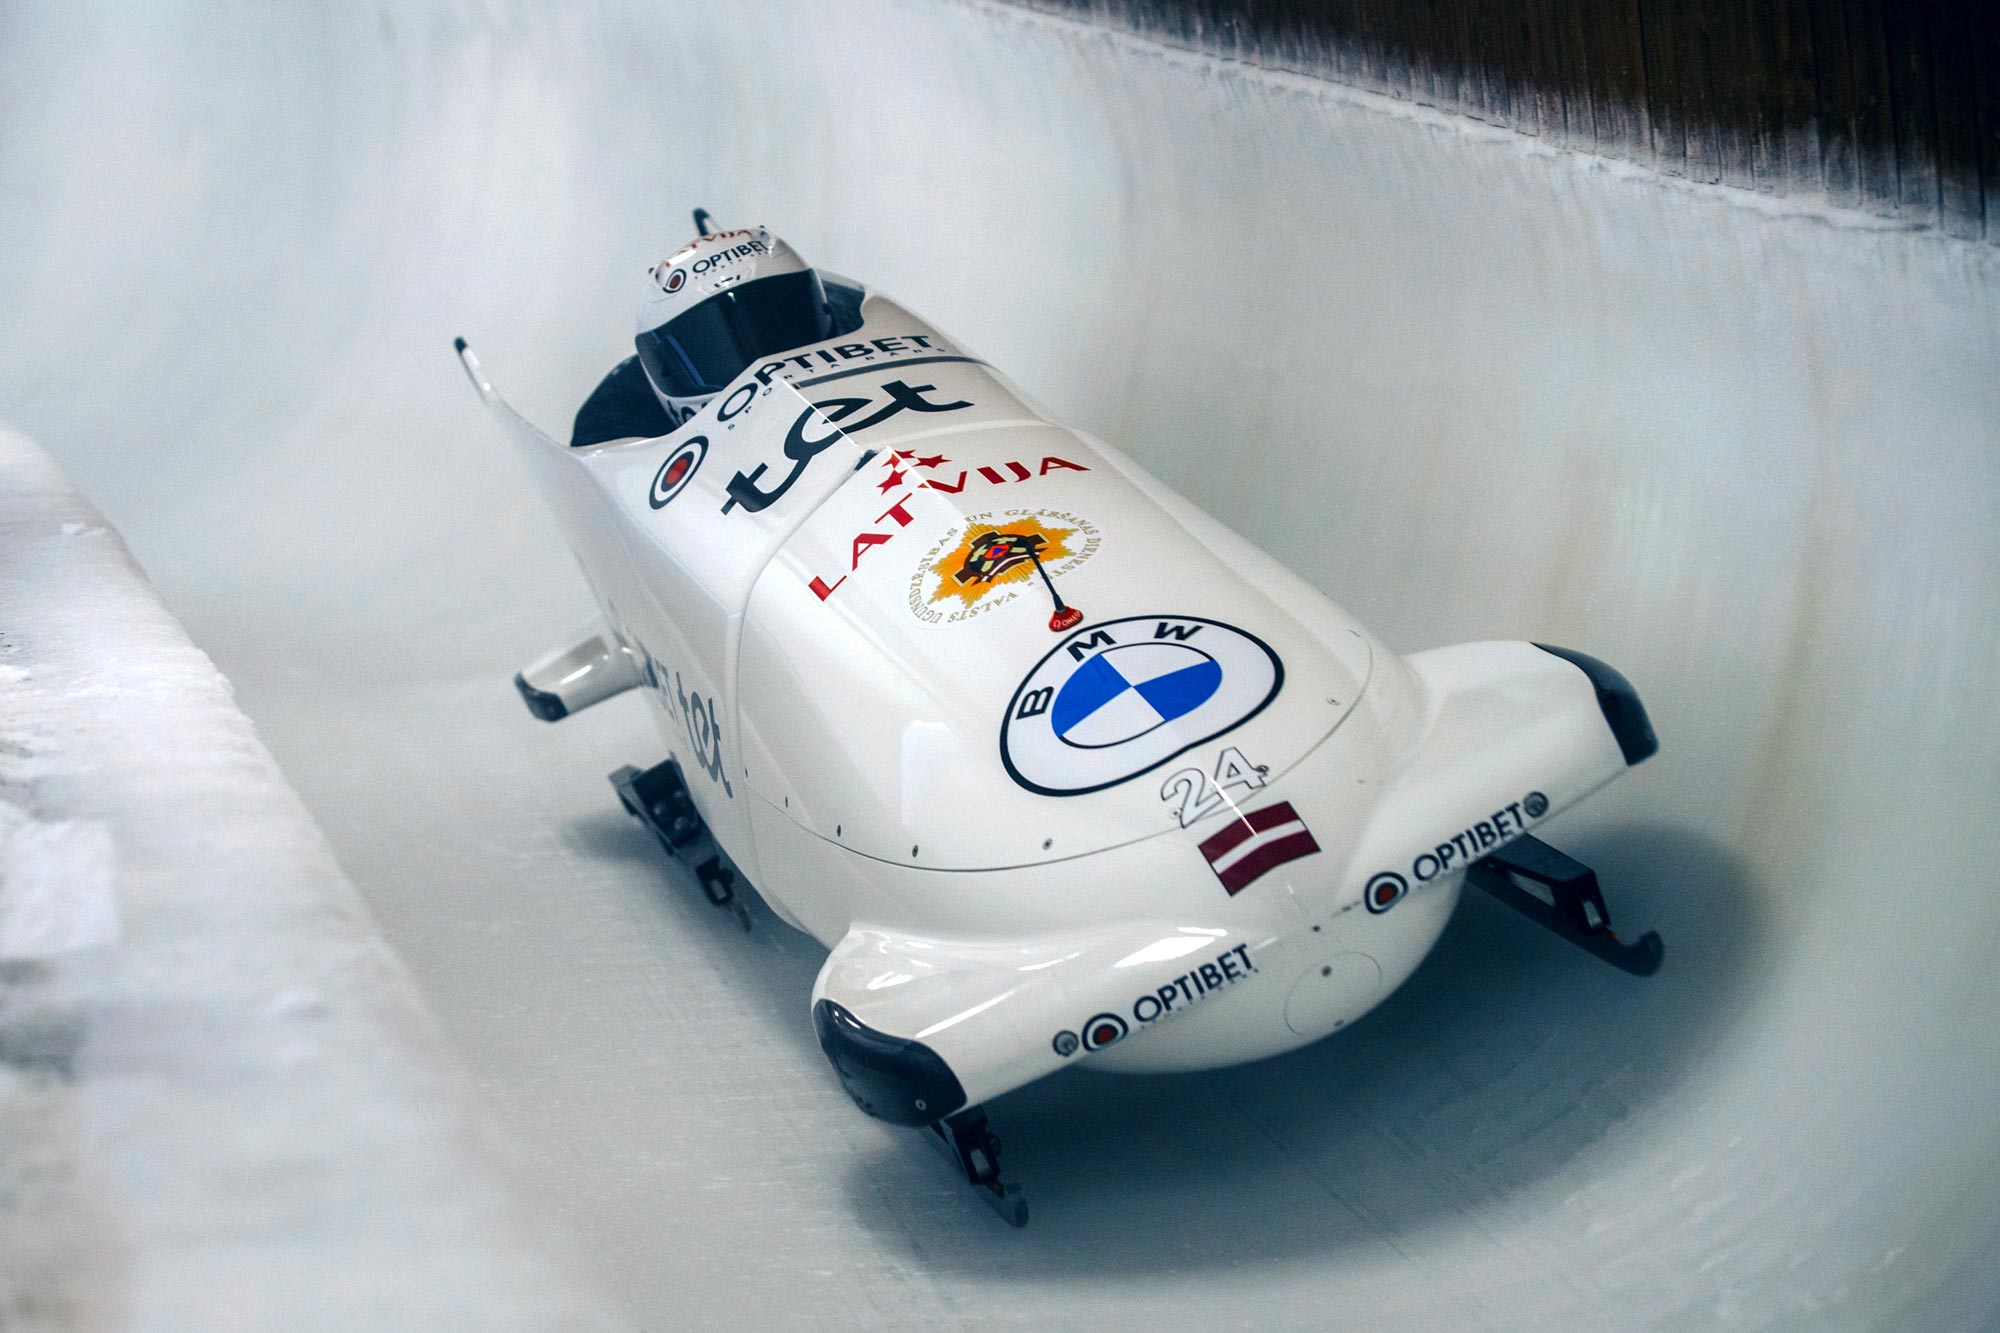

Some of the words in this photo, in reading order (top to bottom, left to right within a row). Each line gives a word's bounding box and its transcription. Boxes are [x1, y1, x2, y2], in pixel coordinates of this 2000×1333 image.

[692, 241, 769, 274] OPTIBET
[717, 335, 932, 422] OPTIBET
[808, 456, 1092, 602] LATVIJA
[1016, 621, 1204, 721] BMW
[1160, 746, 1269, 829] 24
[1413, 802, 1525, 881] OPTIBET
[1133, 943, 1253, 1023] OPTIBET
